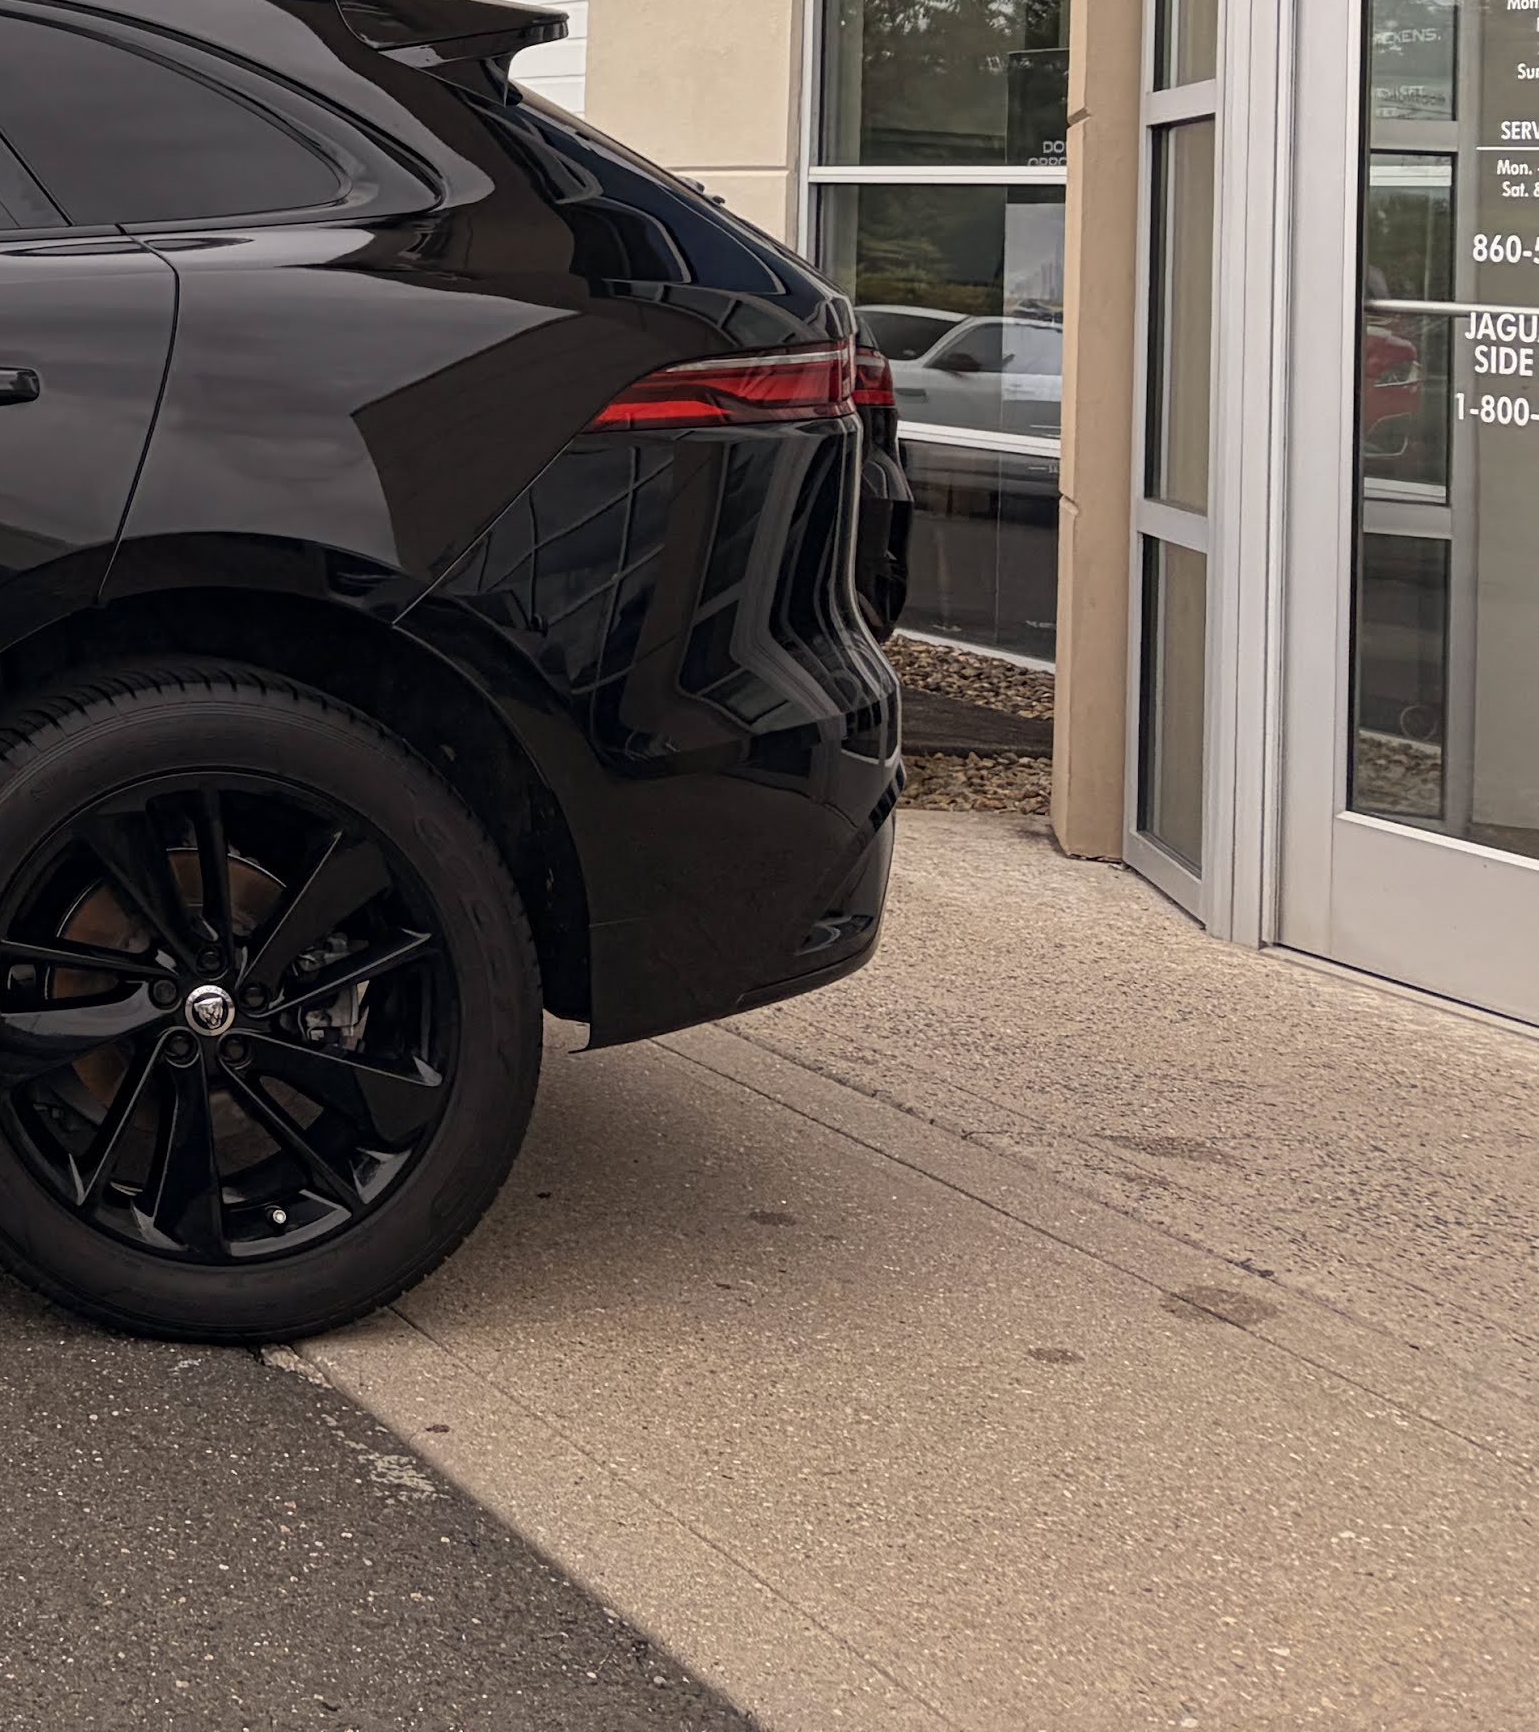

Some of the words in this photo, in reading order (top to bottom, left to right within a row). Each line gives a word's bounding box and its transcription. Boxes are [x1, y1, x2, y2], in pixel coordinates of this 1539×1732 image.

[1496, 159, 1533, 175] Mon.
[1502, 181, 1529, 197] Sat.
[1474, 344, 1534, 377] SIDE
